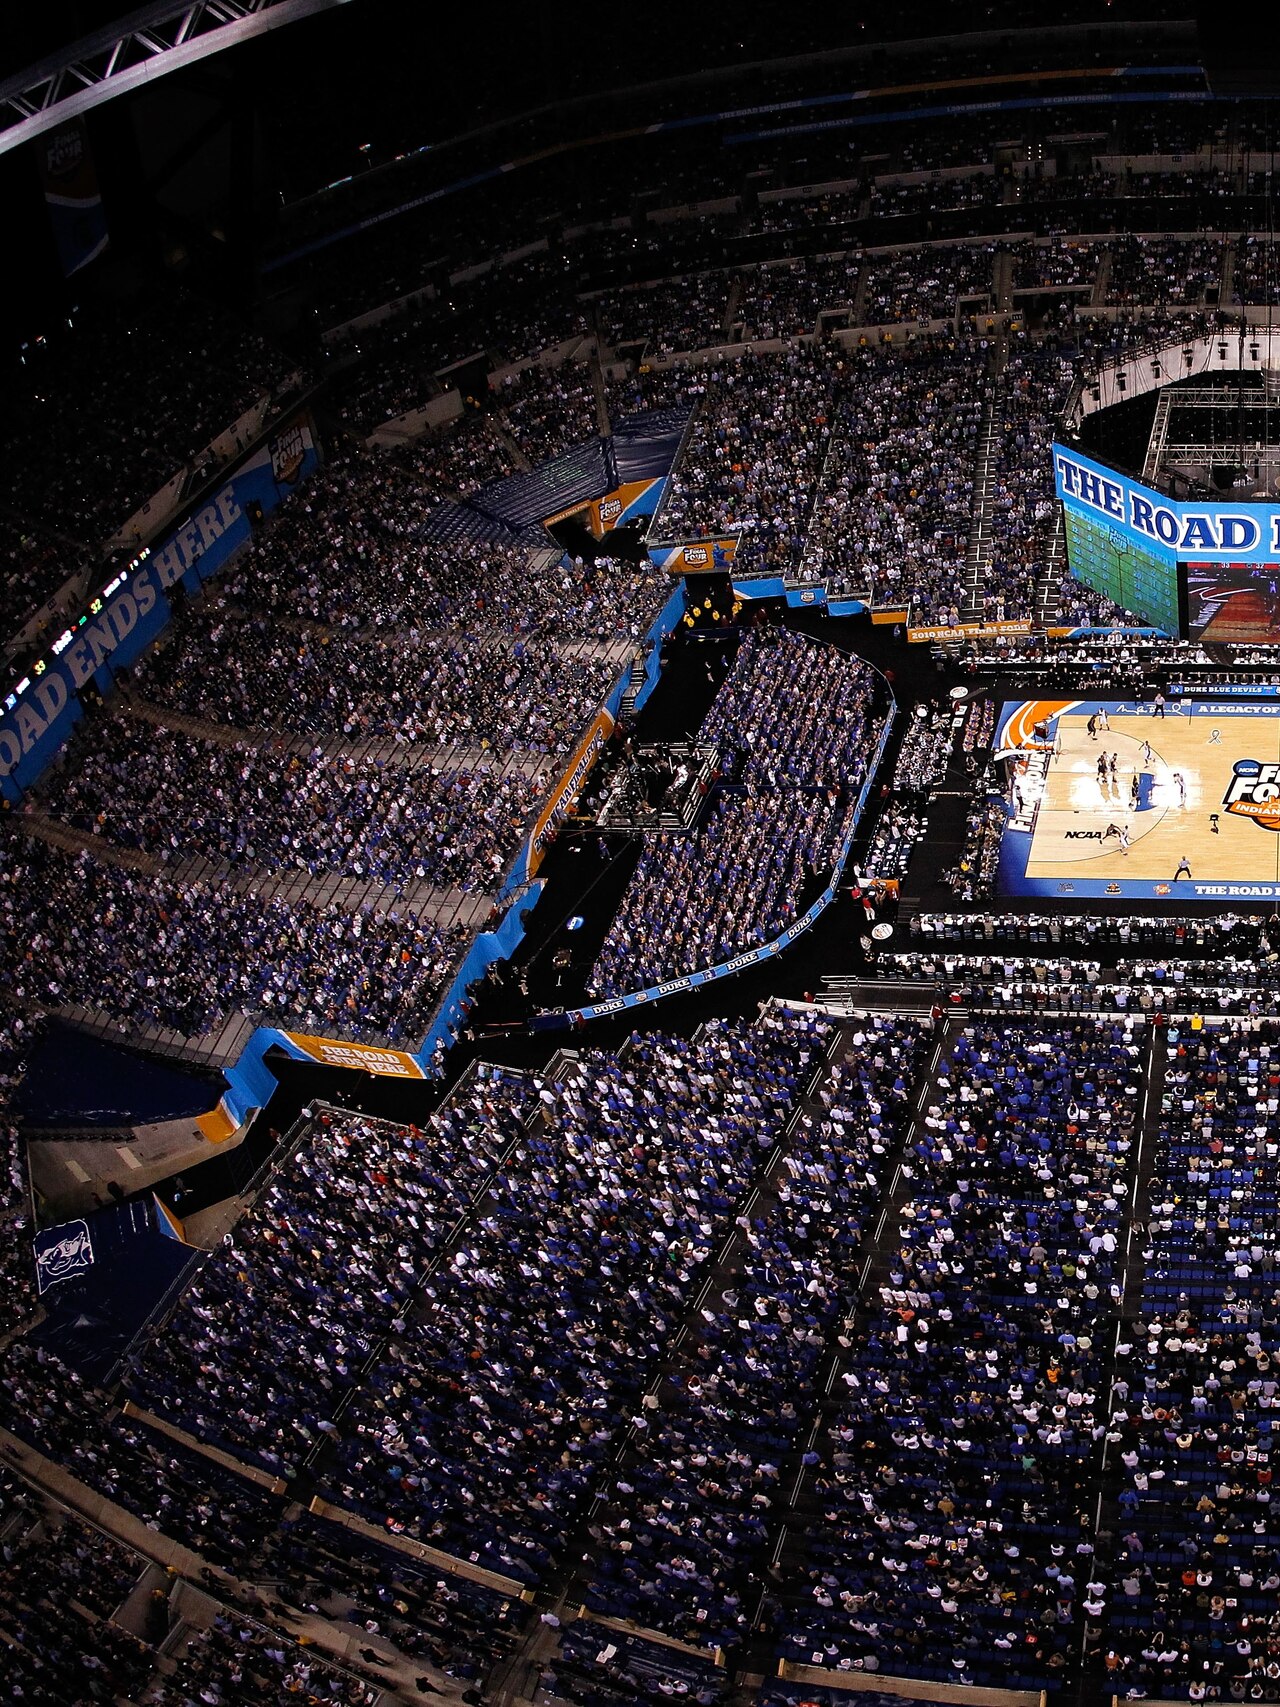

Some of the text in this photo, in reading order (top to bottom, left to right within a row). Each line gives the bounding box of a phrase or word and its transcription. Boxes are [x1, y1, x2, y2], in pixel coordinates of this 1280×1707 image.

[271, 426, 304, 479] FINAL FOUR
[600, 504, 621, 516] FOUR
[1058, 457, 1125, 522] THE
[1129, 491, 1260, 552] ROAD
[685, 554, 707, 562] FOUR
[0, 484, 242, 788] OAD ENDS HERE
[912, 631, 936, 640] 2010
[1198, 706, 1209, 714] A
[1209, 706, 1262, 714] LEGACY
[1262, 706, 1280, 714] OF
[1064, 831, 1102, 839] NCAA
[1194, 886, 1227, 895] THE
[1229, 886, 1273, 896] ROAD
[787, 915, 813, 940] DUKE
[726, 952, 758, 971] DUKE
[658, 979, 690, 995] DUKE
[592, 1000, 625, 1015] DUKE
[320, 1045, 400, 1065] THE ROAD
[321, 1053, 410, 1076] ENDS HERE
